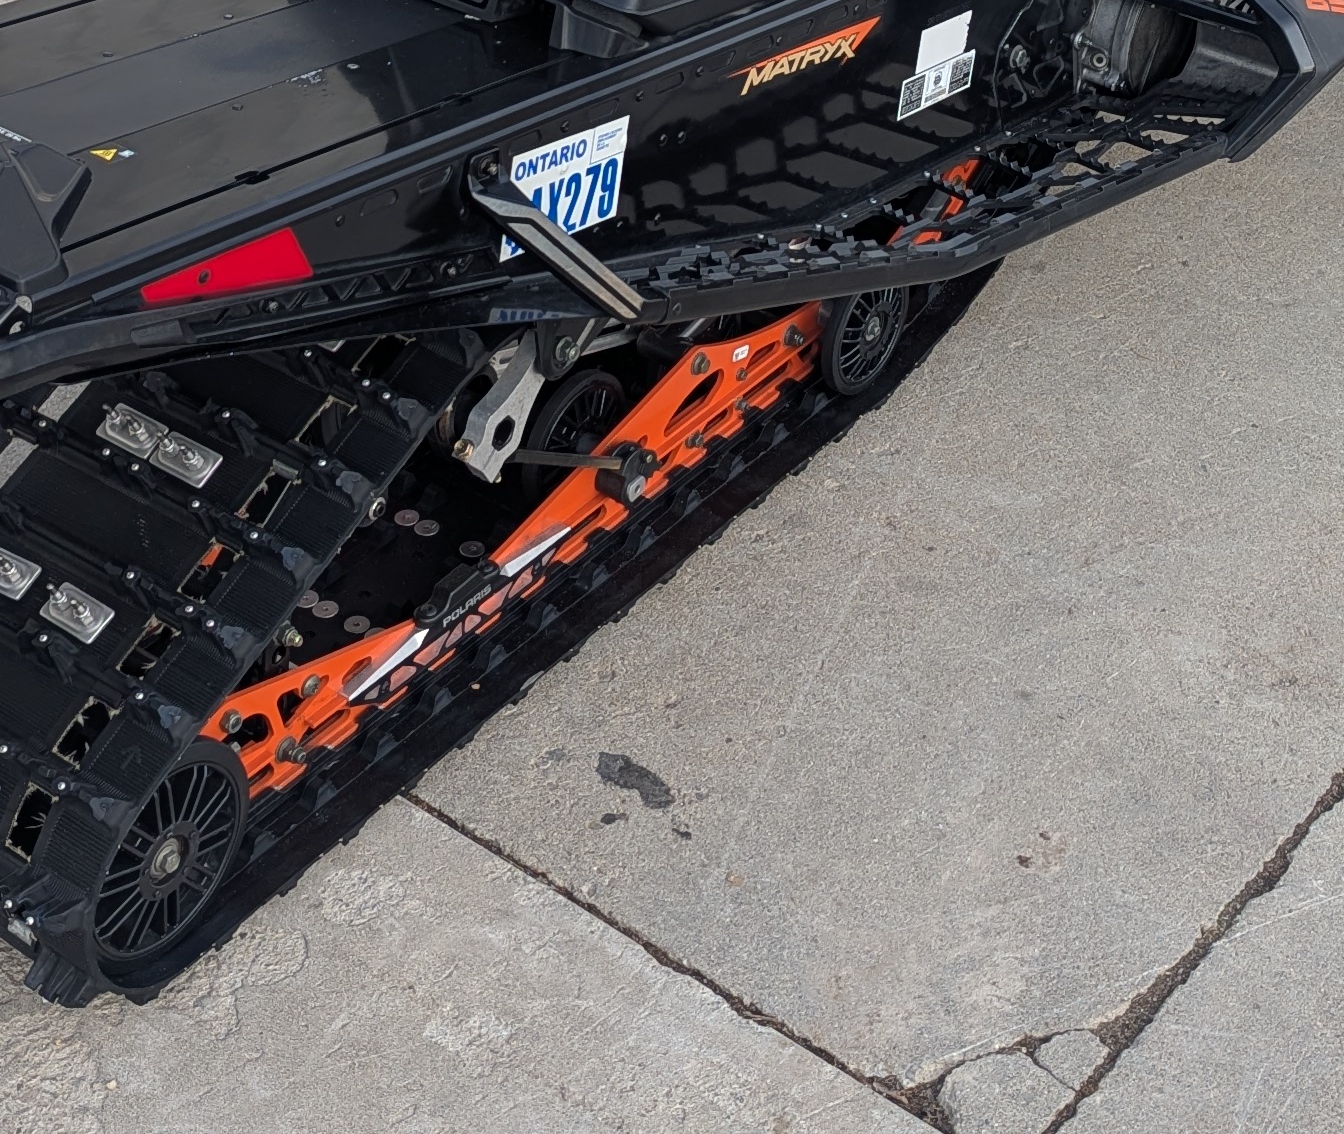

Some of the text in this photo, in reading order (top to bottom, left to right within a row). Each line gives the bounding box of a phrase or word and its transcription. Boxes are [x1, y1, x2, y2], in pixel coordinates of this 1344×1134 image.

[740, 33, 856, 96] MATRYX
[514, 138, 588, 182] ONTARIO
[443, 584, 492, 628] POLARIS
